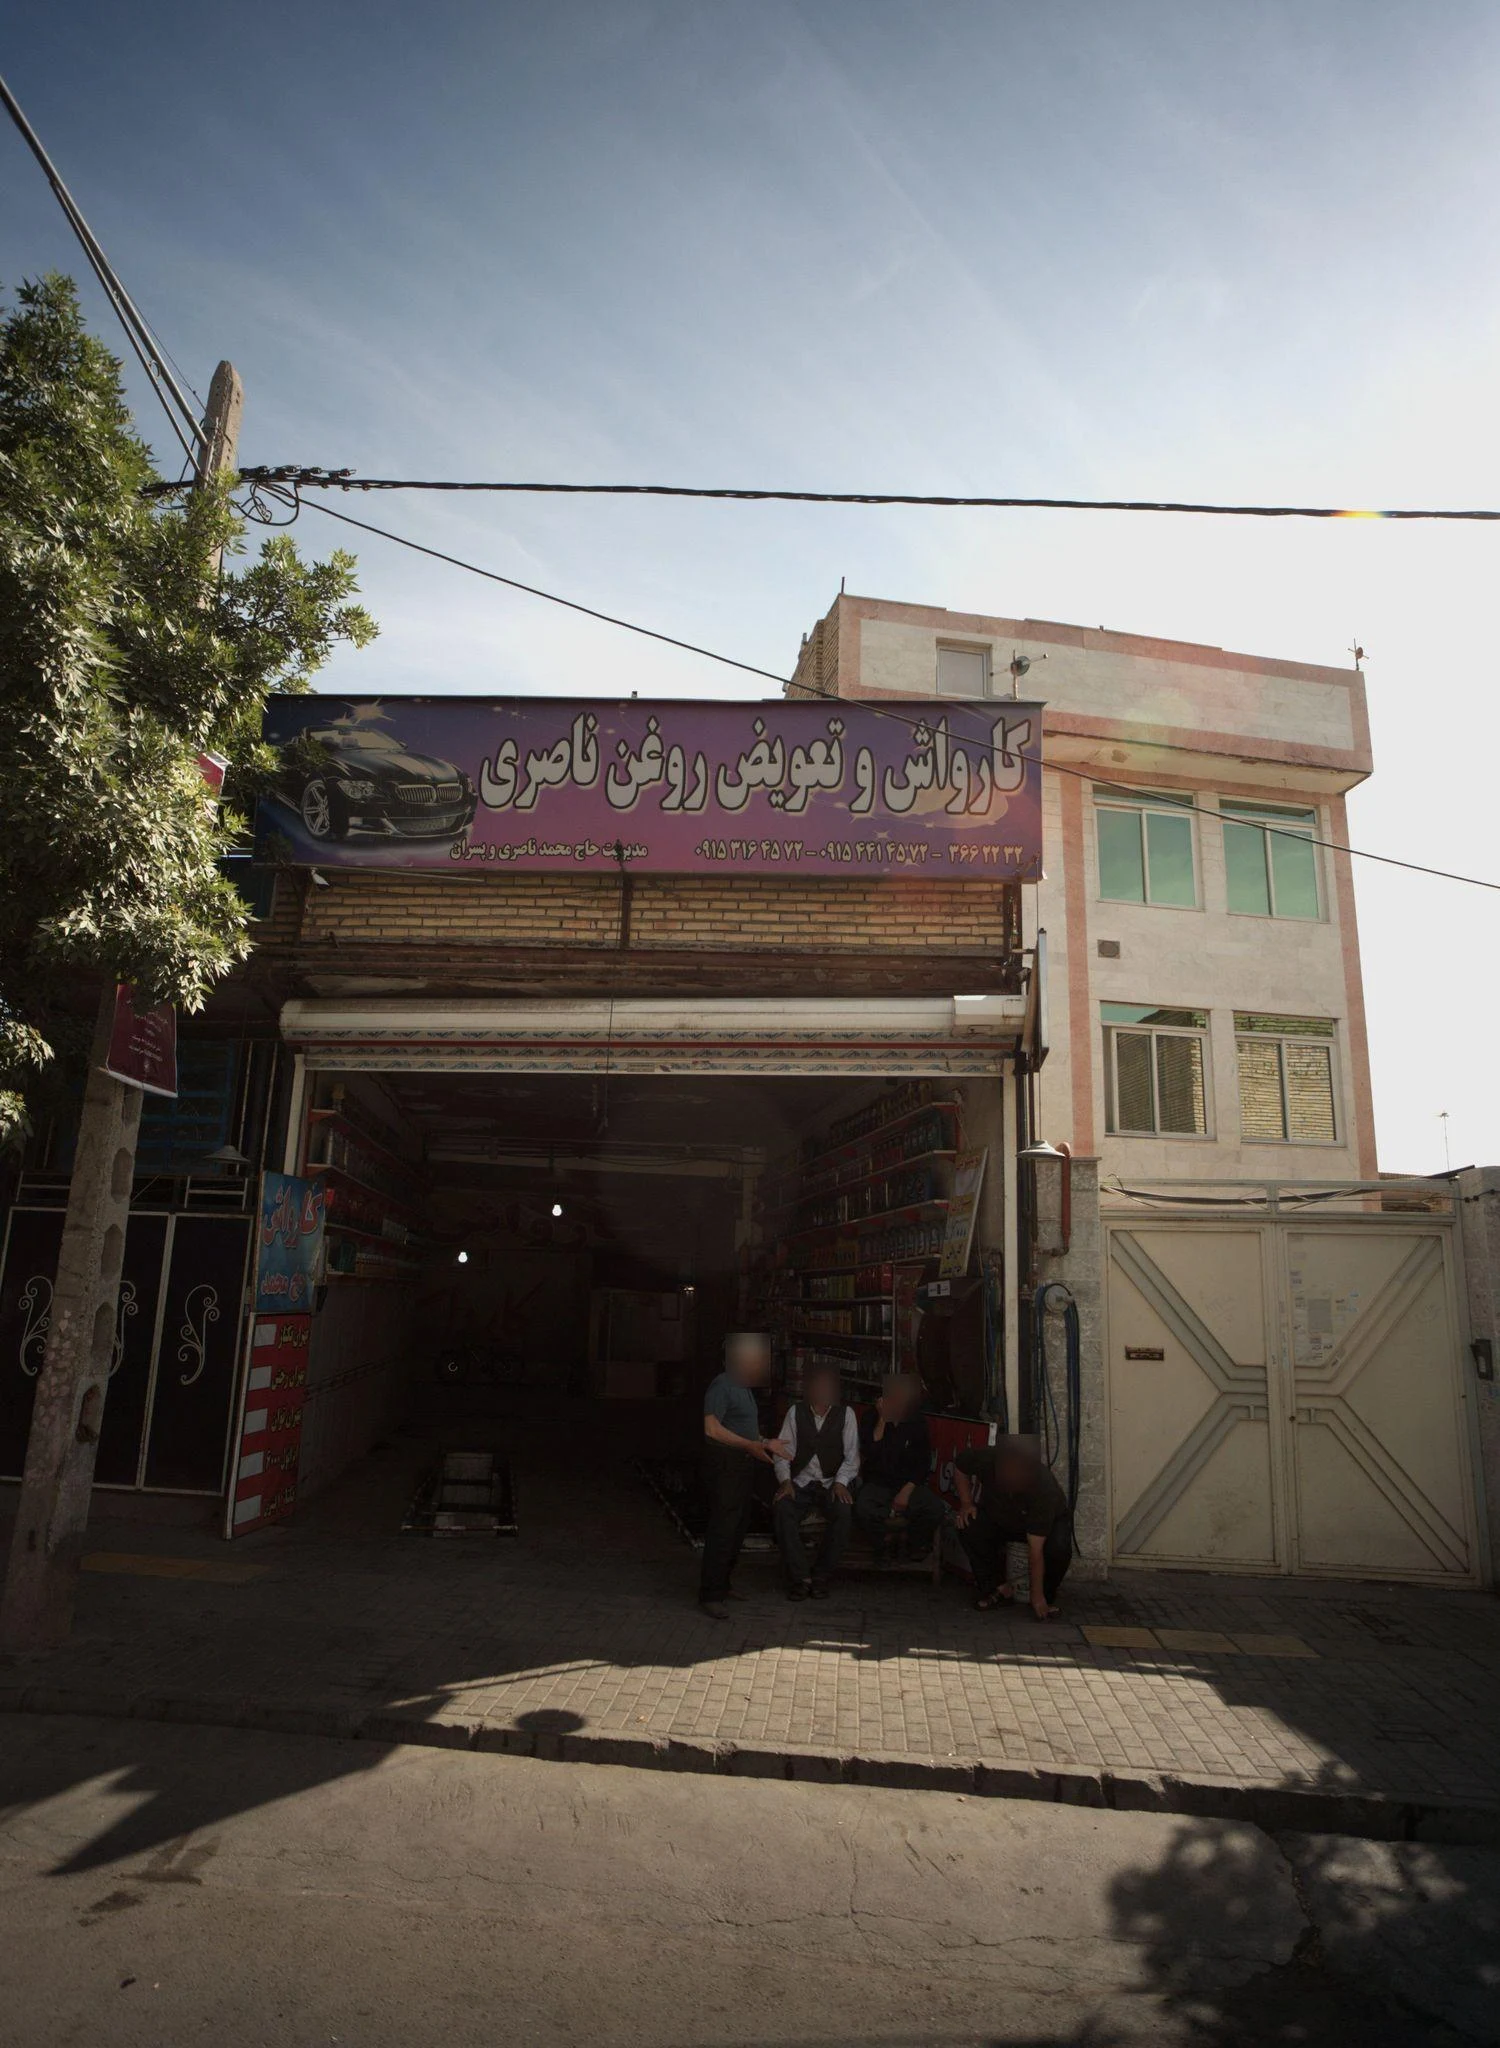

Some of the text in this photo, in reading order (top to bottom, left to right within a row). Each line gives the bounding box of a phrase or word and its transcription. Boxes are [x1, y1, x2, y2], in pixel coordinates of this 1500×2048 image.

[479, 712, 1032, 815] کارواش و تعویض روغن ناصری
[450, 837, 487, 861] پسران
[488, 843, 496, 860] و
[498, 837, 536, 861] ناصری
[539, 841, 572, 858] محمد
[574, 838, 599, 861] حاج
